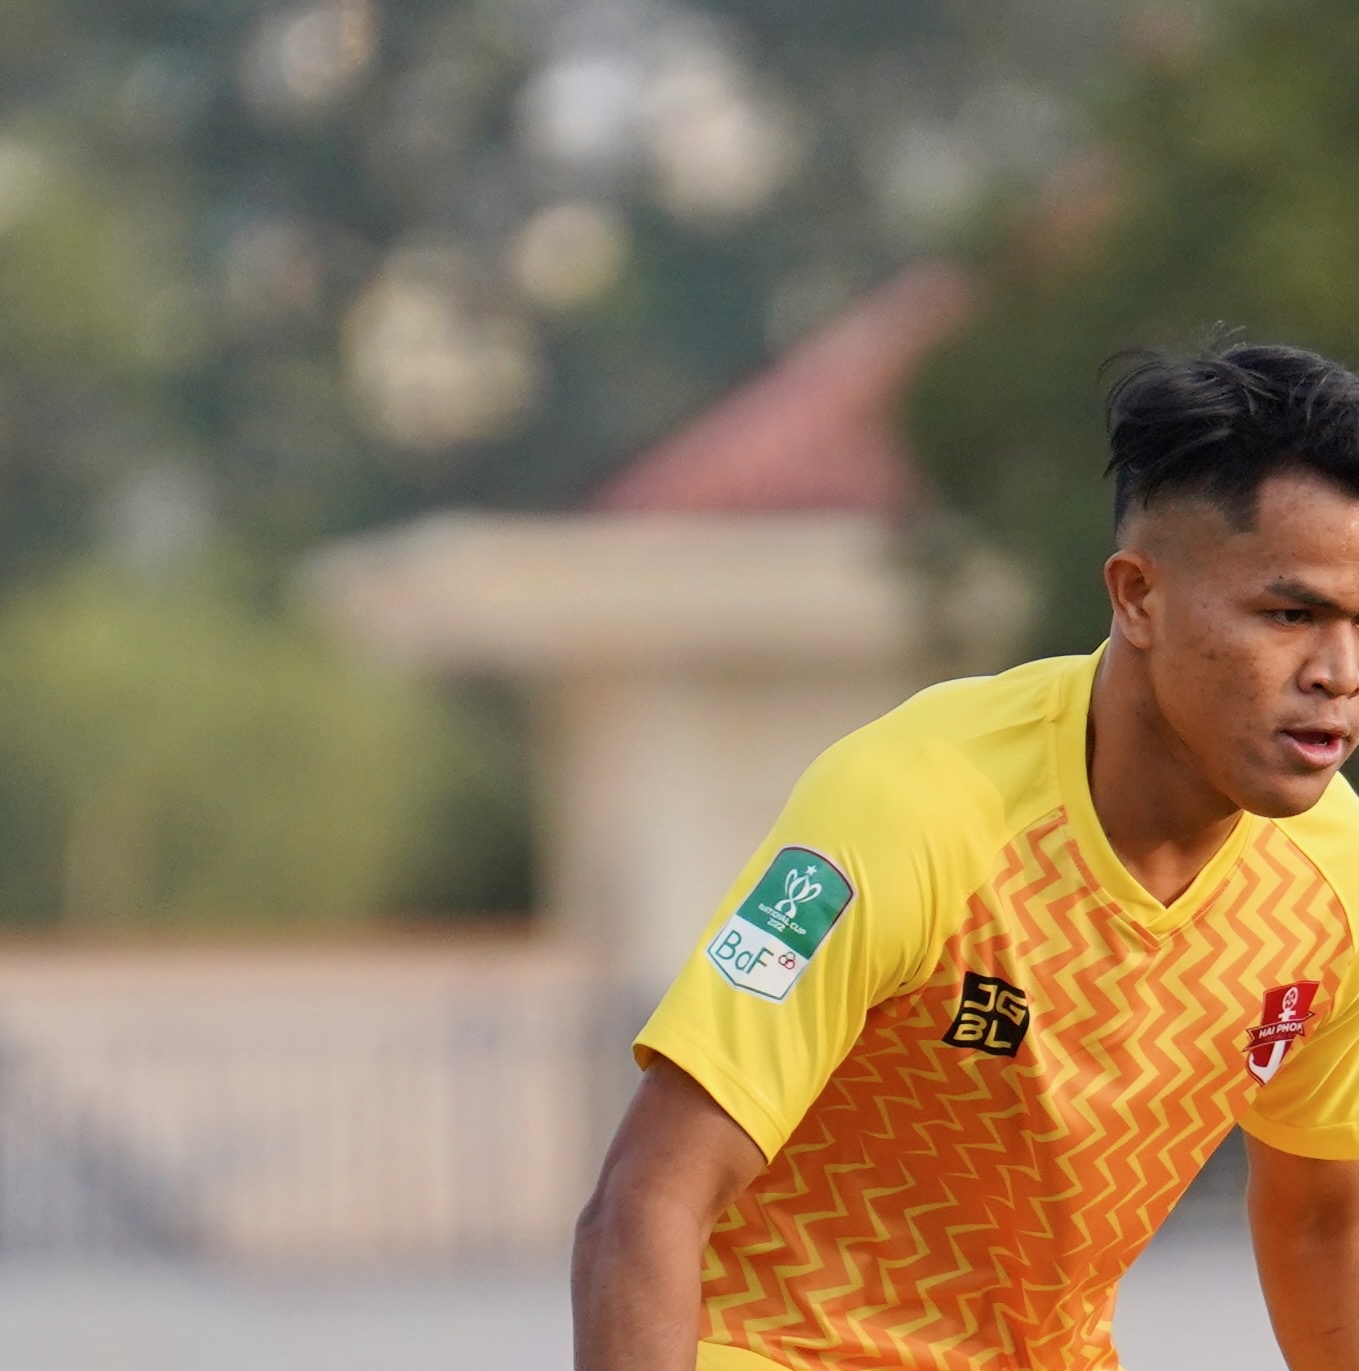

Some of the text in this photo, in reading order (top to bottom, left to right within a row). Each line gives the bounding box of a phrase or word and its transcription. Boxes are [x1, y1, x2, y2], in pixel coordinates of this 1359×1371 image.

[790, 922, 807, 934] CUP
[716, 930, 774, 975] BaF
[1259, 1026, 1276, 1039] HAI
